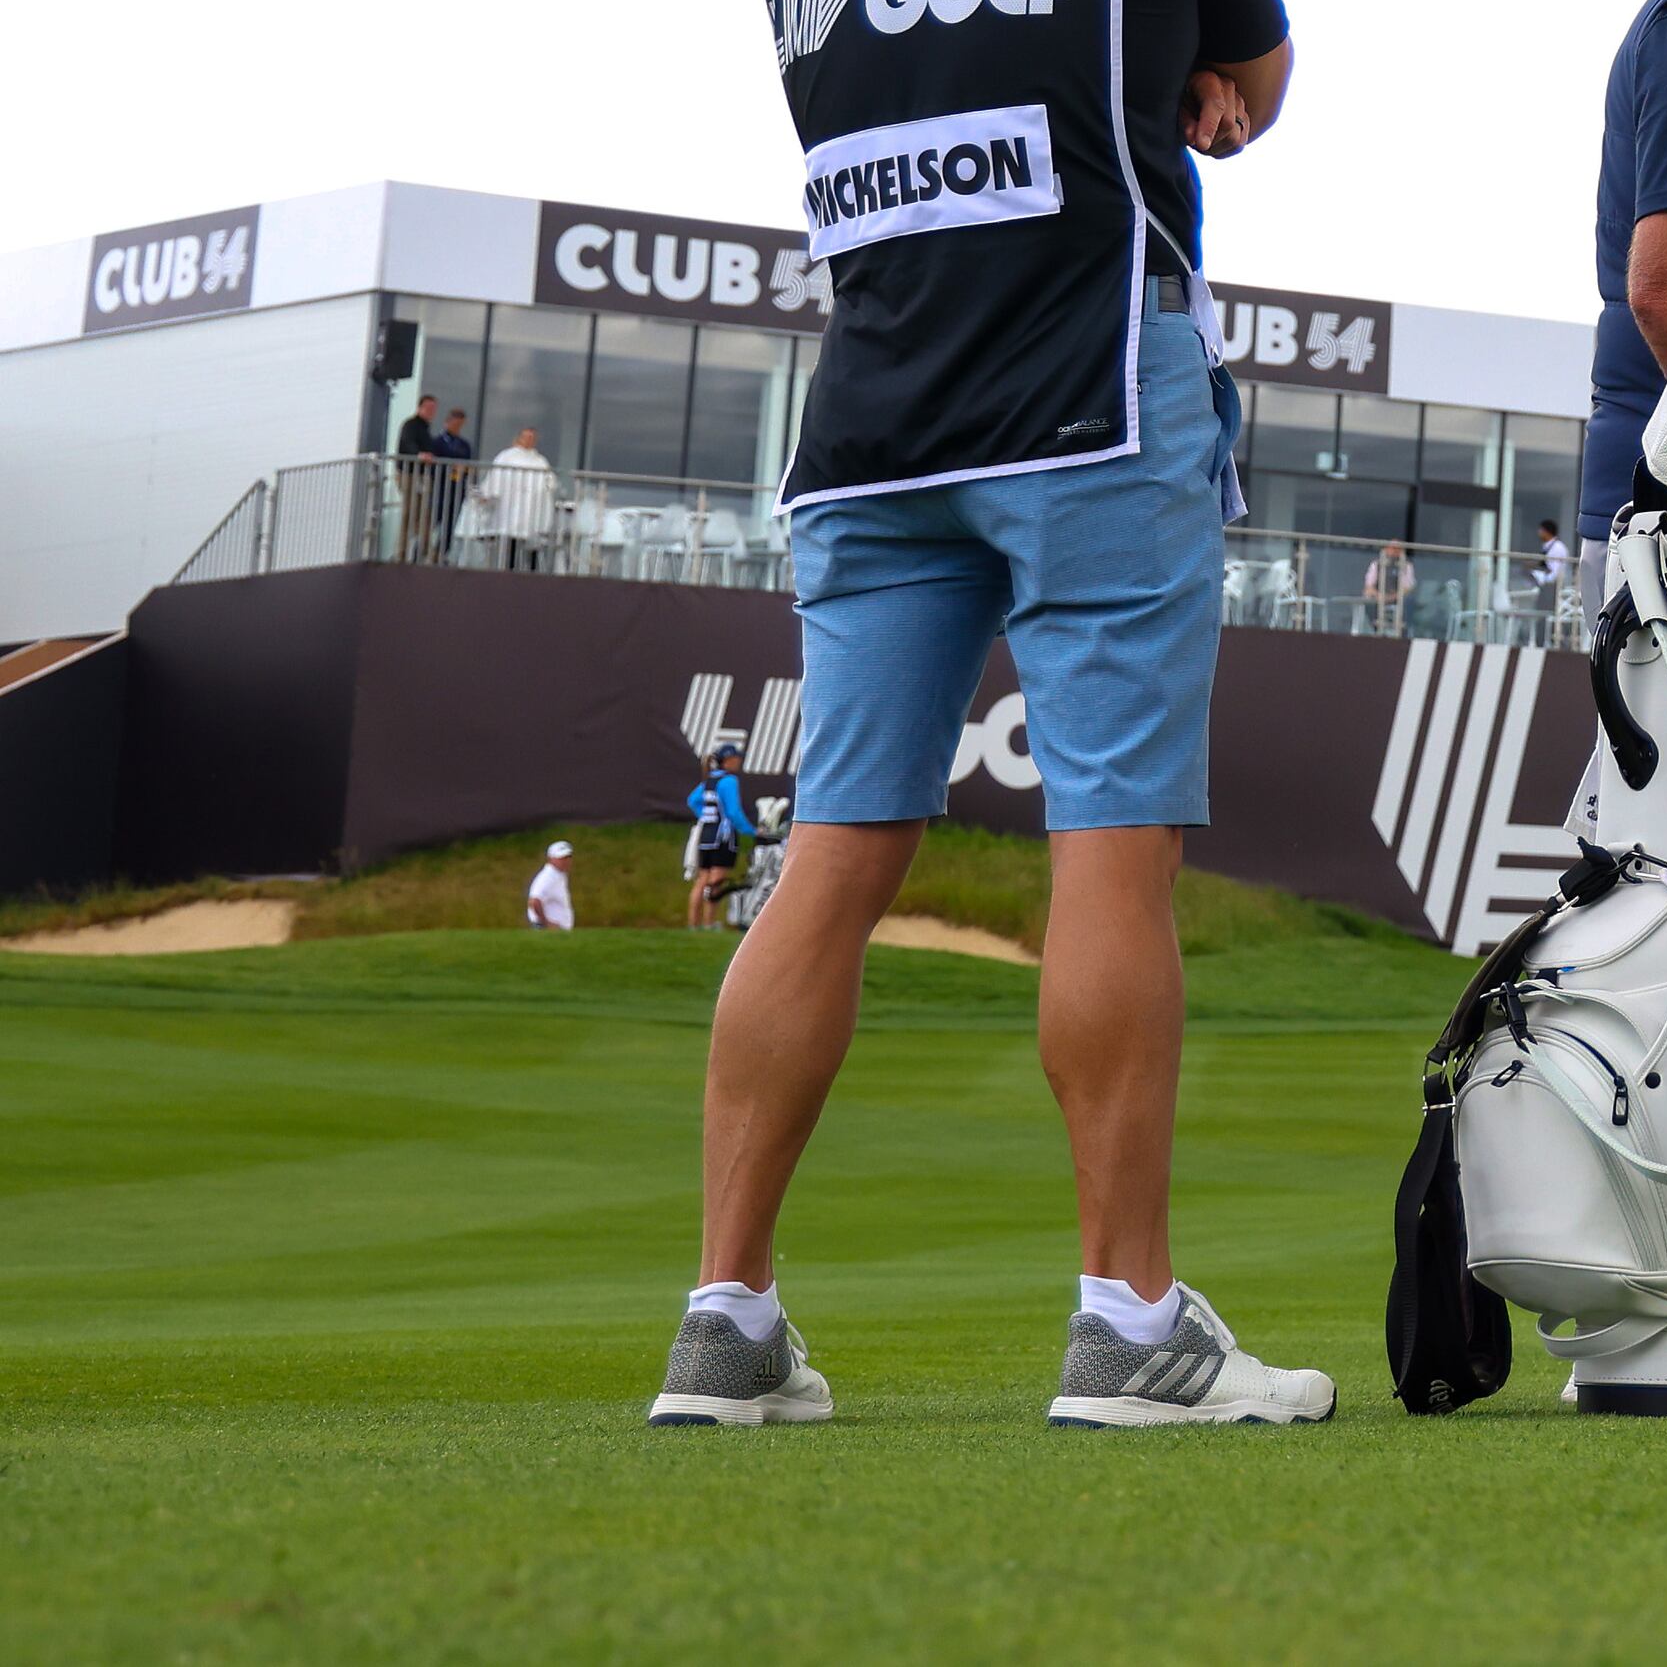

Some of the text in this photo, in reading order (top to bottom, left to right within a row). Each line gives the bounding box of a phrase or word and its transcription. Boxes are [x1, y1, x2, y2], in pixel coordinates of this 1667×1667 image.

[95, 226, 249, 313] CLUB 54
[555, 223, 761, 306] CLUB
[1213, 300, 1376, 374] UB 54
[680, 673, 801, 774] LI
